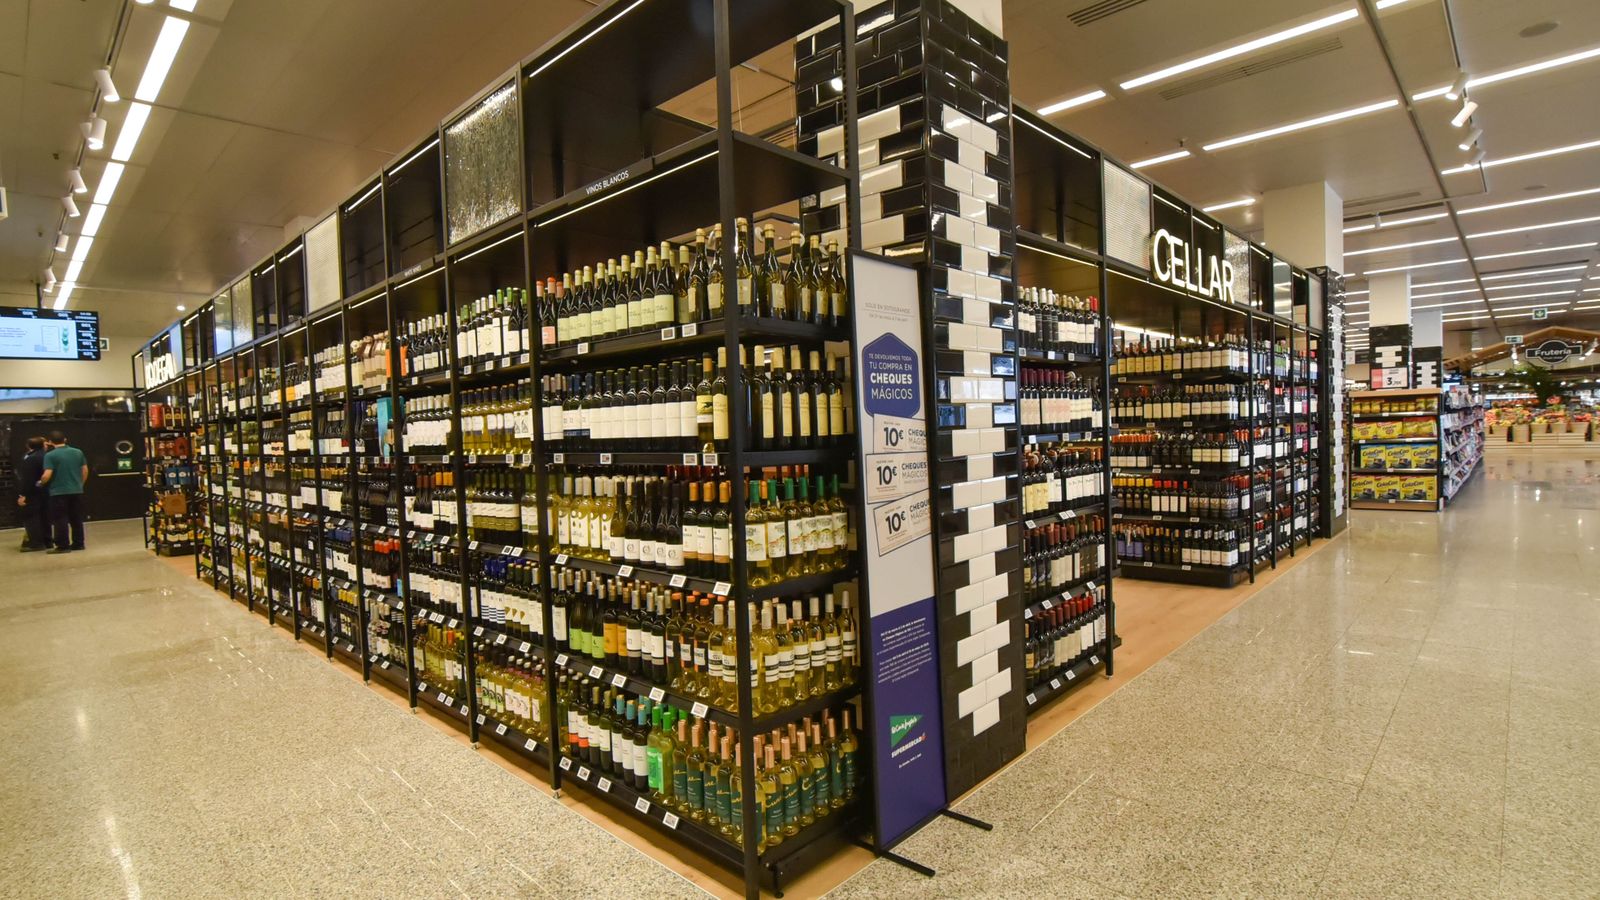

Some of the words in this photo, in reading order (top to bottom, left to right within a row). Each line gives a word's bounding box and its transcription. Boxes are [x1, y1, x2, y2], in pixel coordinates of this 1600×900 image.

[585, 182, 602, 195] VINOS
[602, 170, 629, 188] BLANCOS
[1153, 228, 1235, 304] CELLAR
[145, 352, 176, 390] BODEGA
[869, 361, 878, 369] TU
[878, 362, 903, 371] COMPRA
[904, 363, 913, 371] EN
[870, 373, 913, 385] CHEQUES
[871, 386, 913, 400] MÁGICOS
[883, 427, 904, 447] 10€
[876, 465, 898, 485] 10€
[901, 461, 928, 470] CHEQUES
[885, 511, 906, 534] 10€
